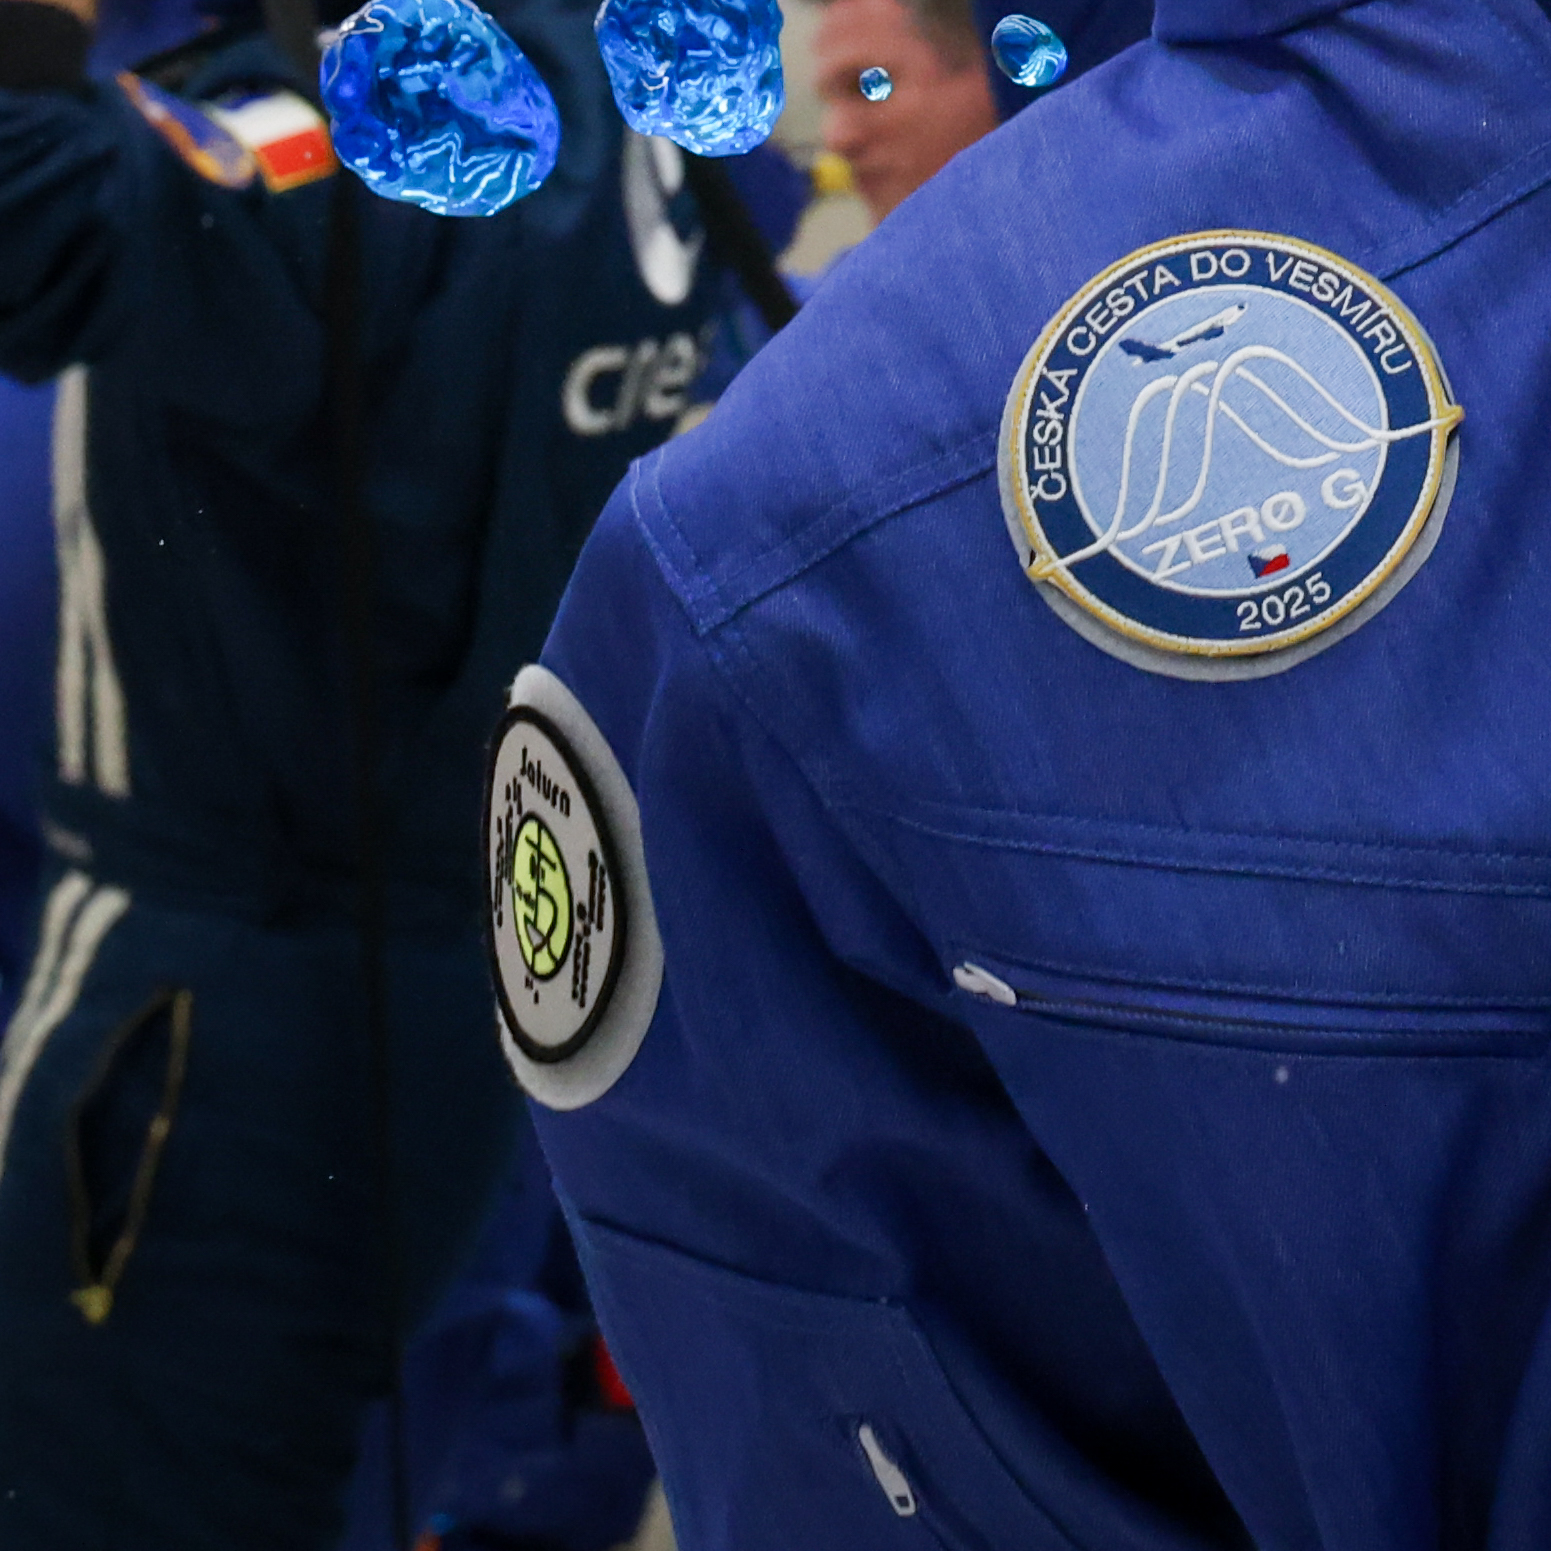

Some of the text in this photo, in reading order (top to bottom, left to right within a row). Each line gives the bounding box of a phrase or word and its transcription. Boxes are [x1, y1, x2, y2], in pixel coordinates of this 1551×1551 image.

[562, 332, 698, 435] cre
[1030, 248, 1413, 502] ČESKÁ CESTA DO VESMÍRU
[1320, 468, 1370, 509] G
[1236, 573, 1332, 632] 2025
